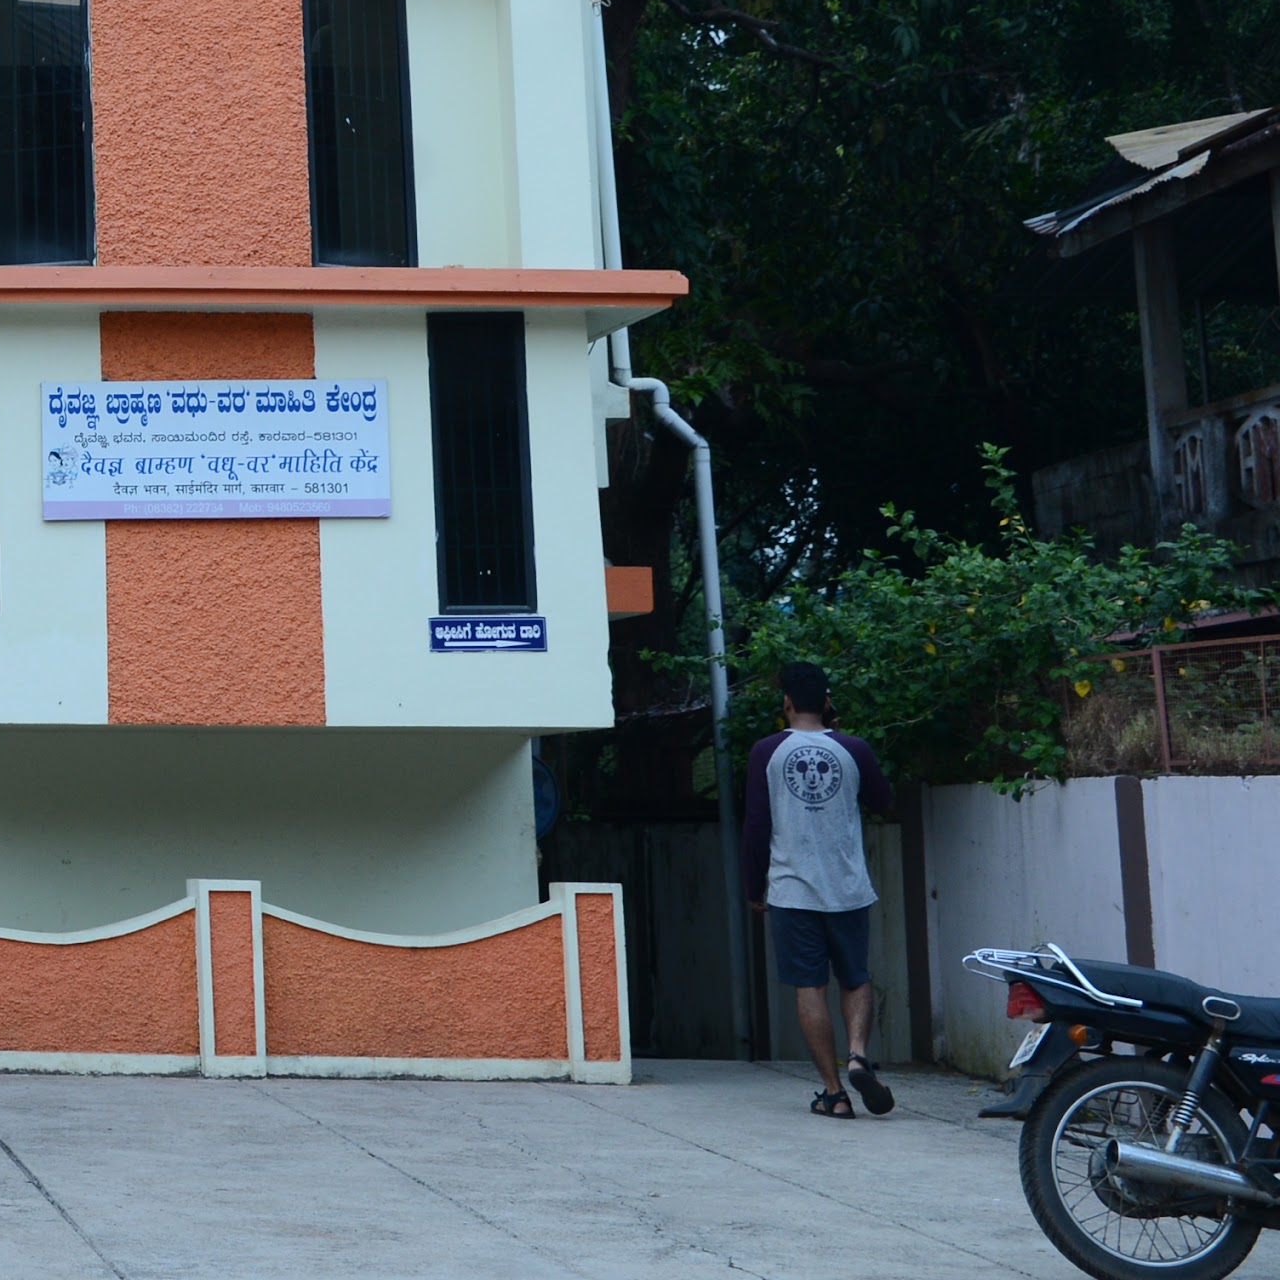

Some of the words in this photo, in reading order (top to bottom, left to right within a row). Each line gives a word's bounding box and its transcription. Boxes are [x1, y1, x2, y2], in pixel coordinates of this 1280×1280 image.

[49, 386, 100, 430] ದೈವಜ್ಞ
[106, 387, 161, 427] ಬ್ರಾಹ್ಮಣ
[255, 385, 316, 413] ಮಾಹಿತಿ
[326, 384, 377, 422] ಕೇಂದ್ರ
[74, 432, 110, 449] ದೈವಜ್ಞ
[151, 431, 226, 443] ಸಾಯಿಮಂದಿರ
[80, 451, 125, 477] दैवज्ञ
[279, 449, 343, 473] माहिति
[349, 449, 379, 473] केंद्र
[113, 482, 138, 495] दैवज्ञ
[250, 484, 285, 494] कारवार
[304, 482, 349, 494] 581301
[520, 625, 541, 639] ದಾರಿ
[787, 749, 811, 774] MICKEY
[816, 750, 840, 774] MOUSE
